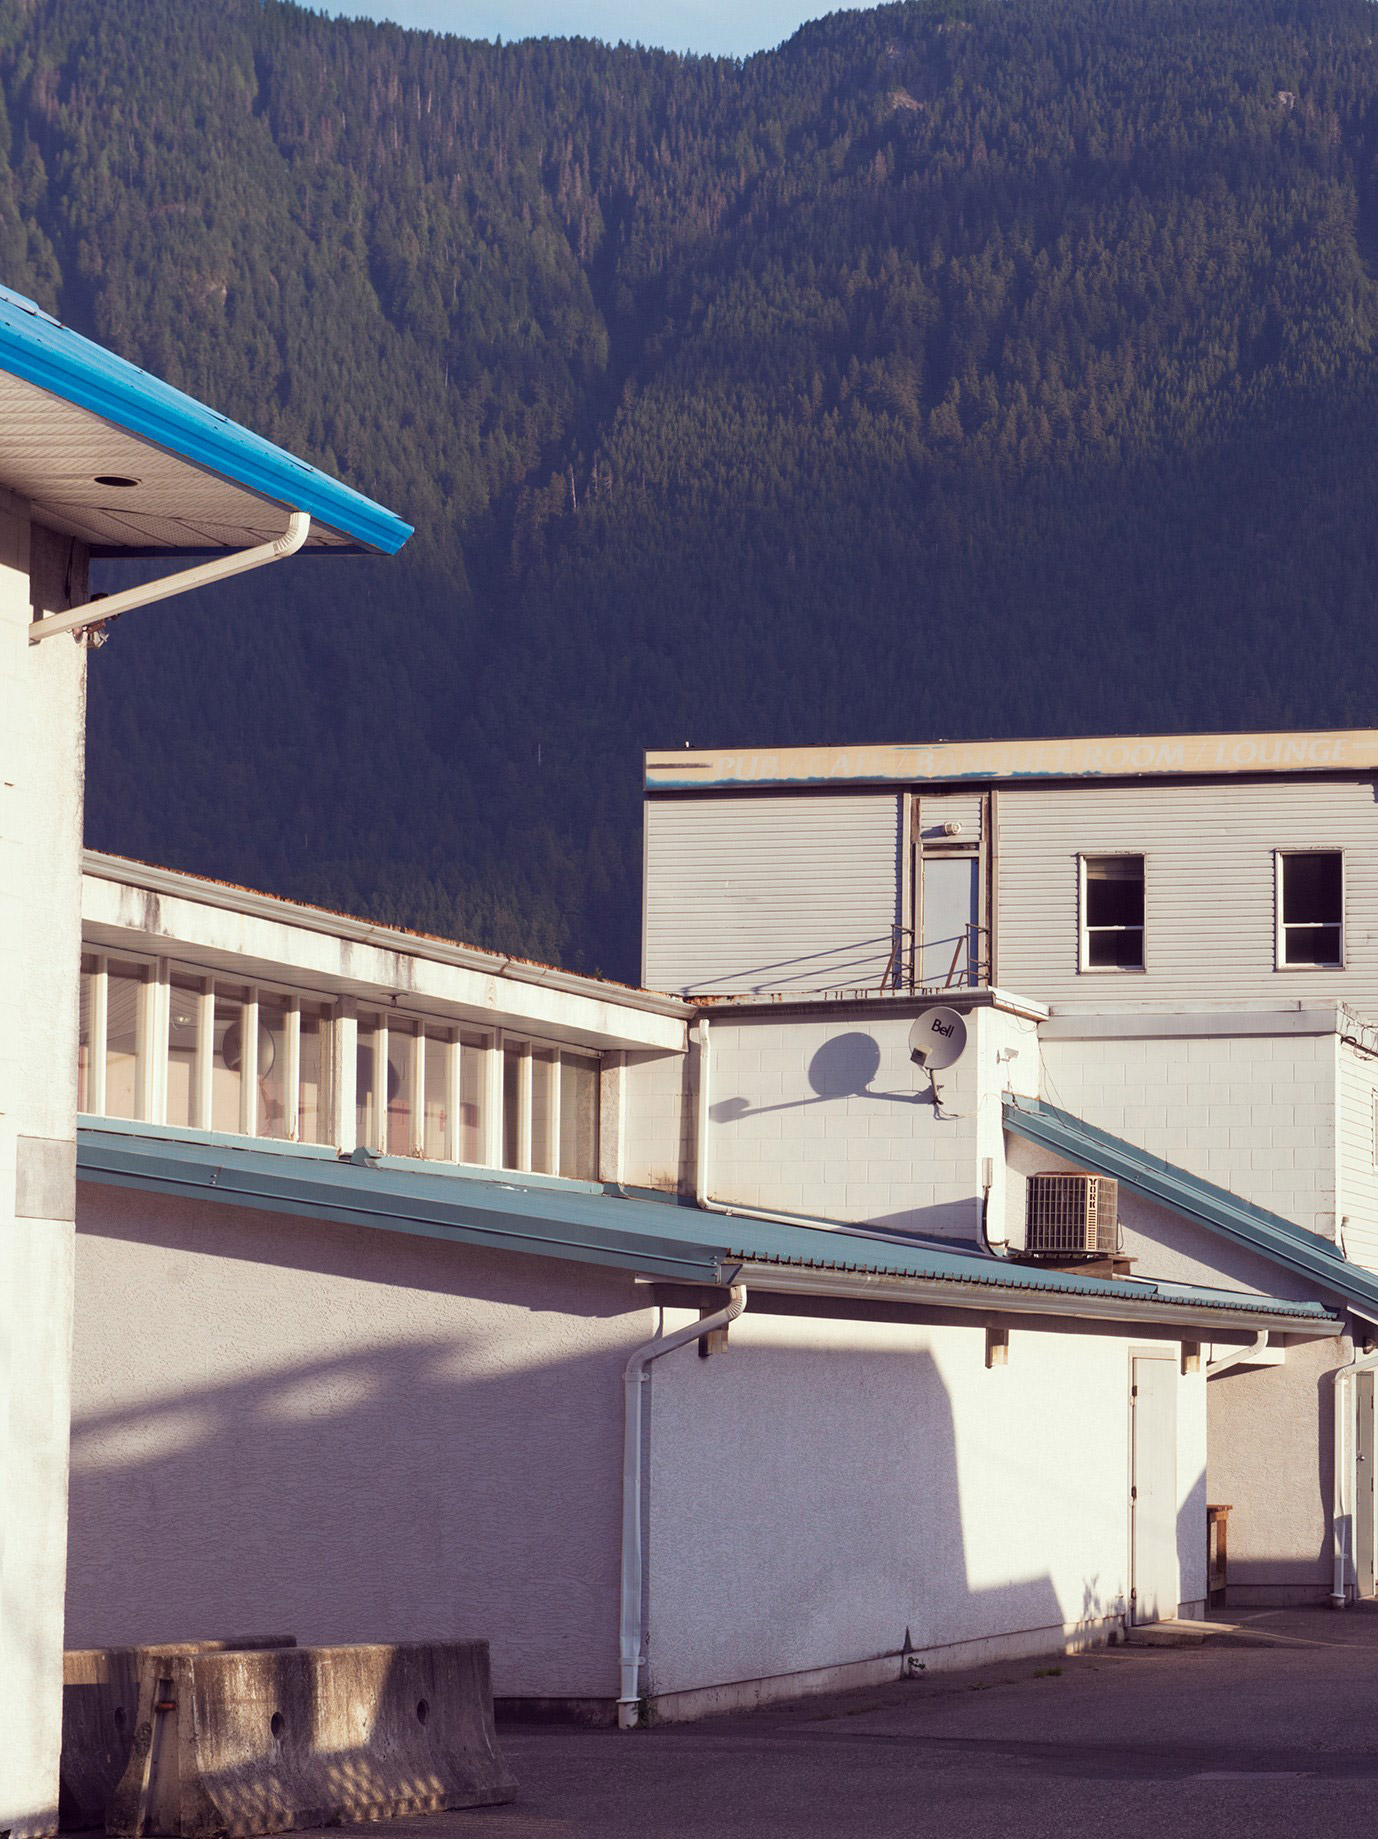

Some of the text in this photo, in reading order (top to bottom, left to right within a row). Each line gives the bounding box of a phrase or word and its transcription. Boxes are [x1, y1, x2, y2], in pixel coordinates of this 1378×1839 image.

[716, 754, 779, 780] PUB
[1082, 742, 1184, 770] ROOM
[1214, 737, 1349, 766] LOUNGE
[931, 1018, 955, 1038] Bell
[1088, 1178, 1098, 1209] YORK
